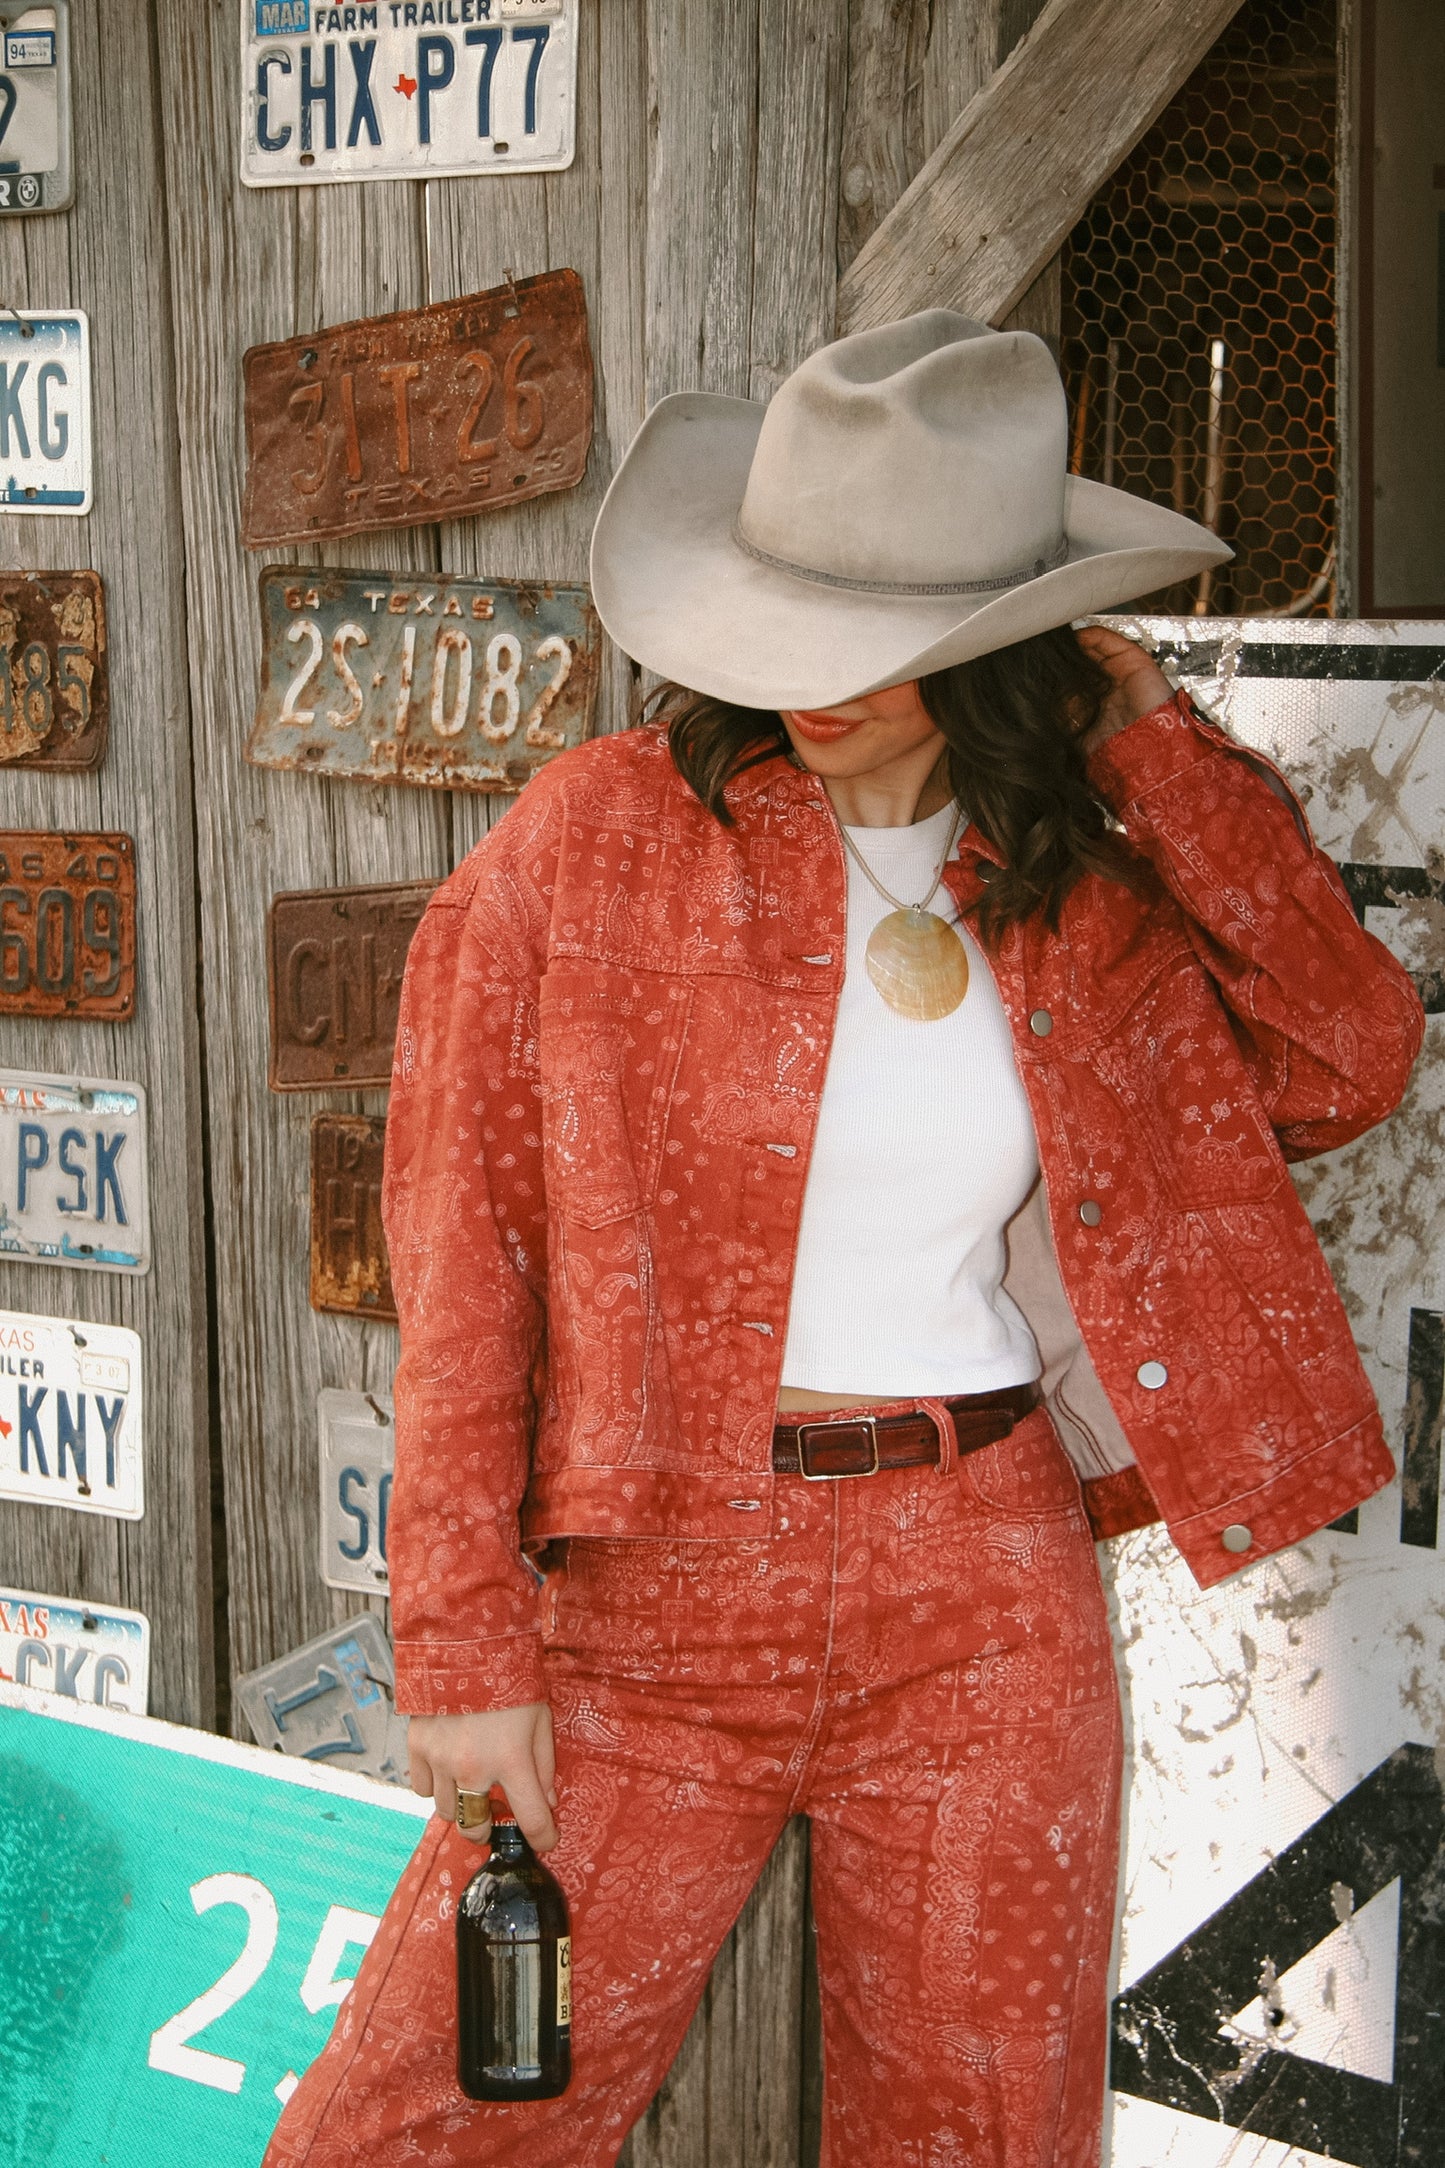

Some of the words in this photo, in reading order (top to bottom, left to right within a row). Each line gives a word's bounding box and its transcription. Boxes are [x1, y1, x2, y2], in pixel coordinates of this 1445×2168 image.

[261, 1, 307, 29] MAR
[315, 6, 378, 33] FARM
[389, 1, 491, 28] TRAILER
[10, 44, 26, 59] 94
[257, 39, 382, 151] CHX
[418, 25, 550, 144] P77
[0, 361, 69, 460] KG
[454, 335, 546, 463] 26
[344, 466, 491, 508] TEXAS
[363, 591, 496, 621] TEXAS
[279, 619, 369, 728] 2S
[395, 625, 573, 748] 1082
[66, 854, 119, 881] 40
[17, 1122, 129, 1226] PSK
[18, 1383, 125, 1489] KNY
